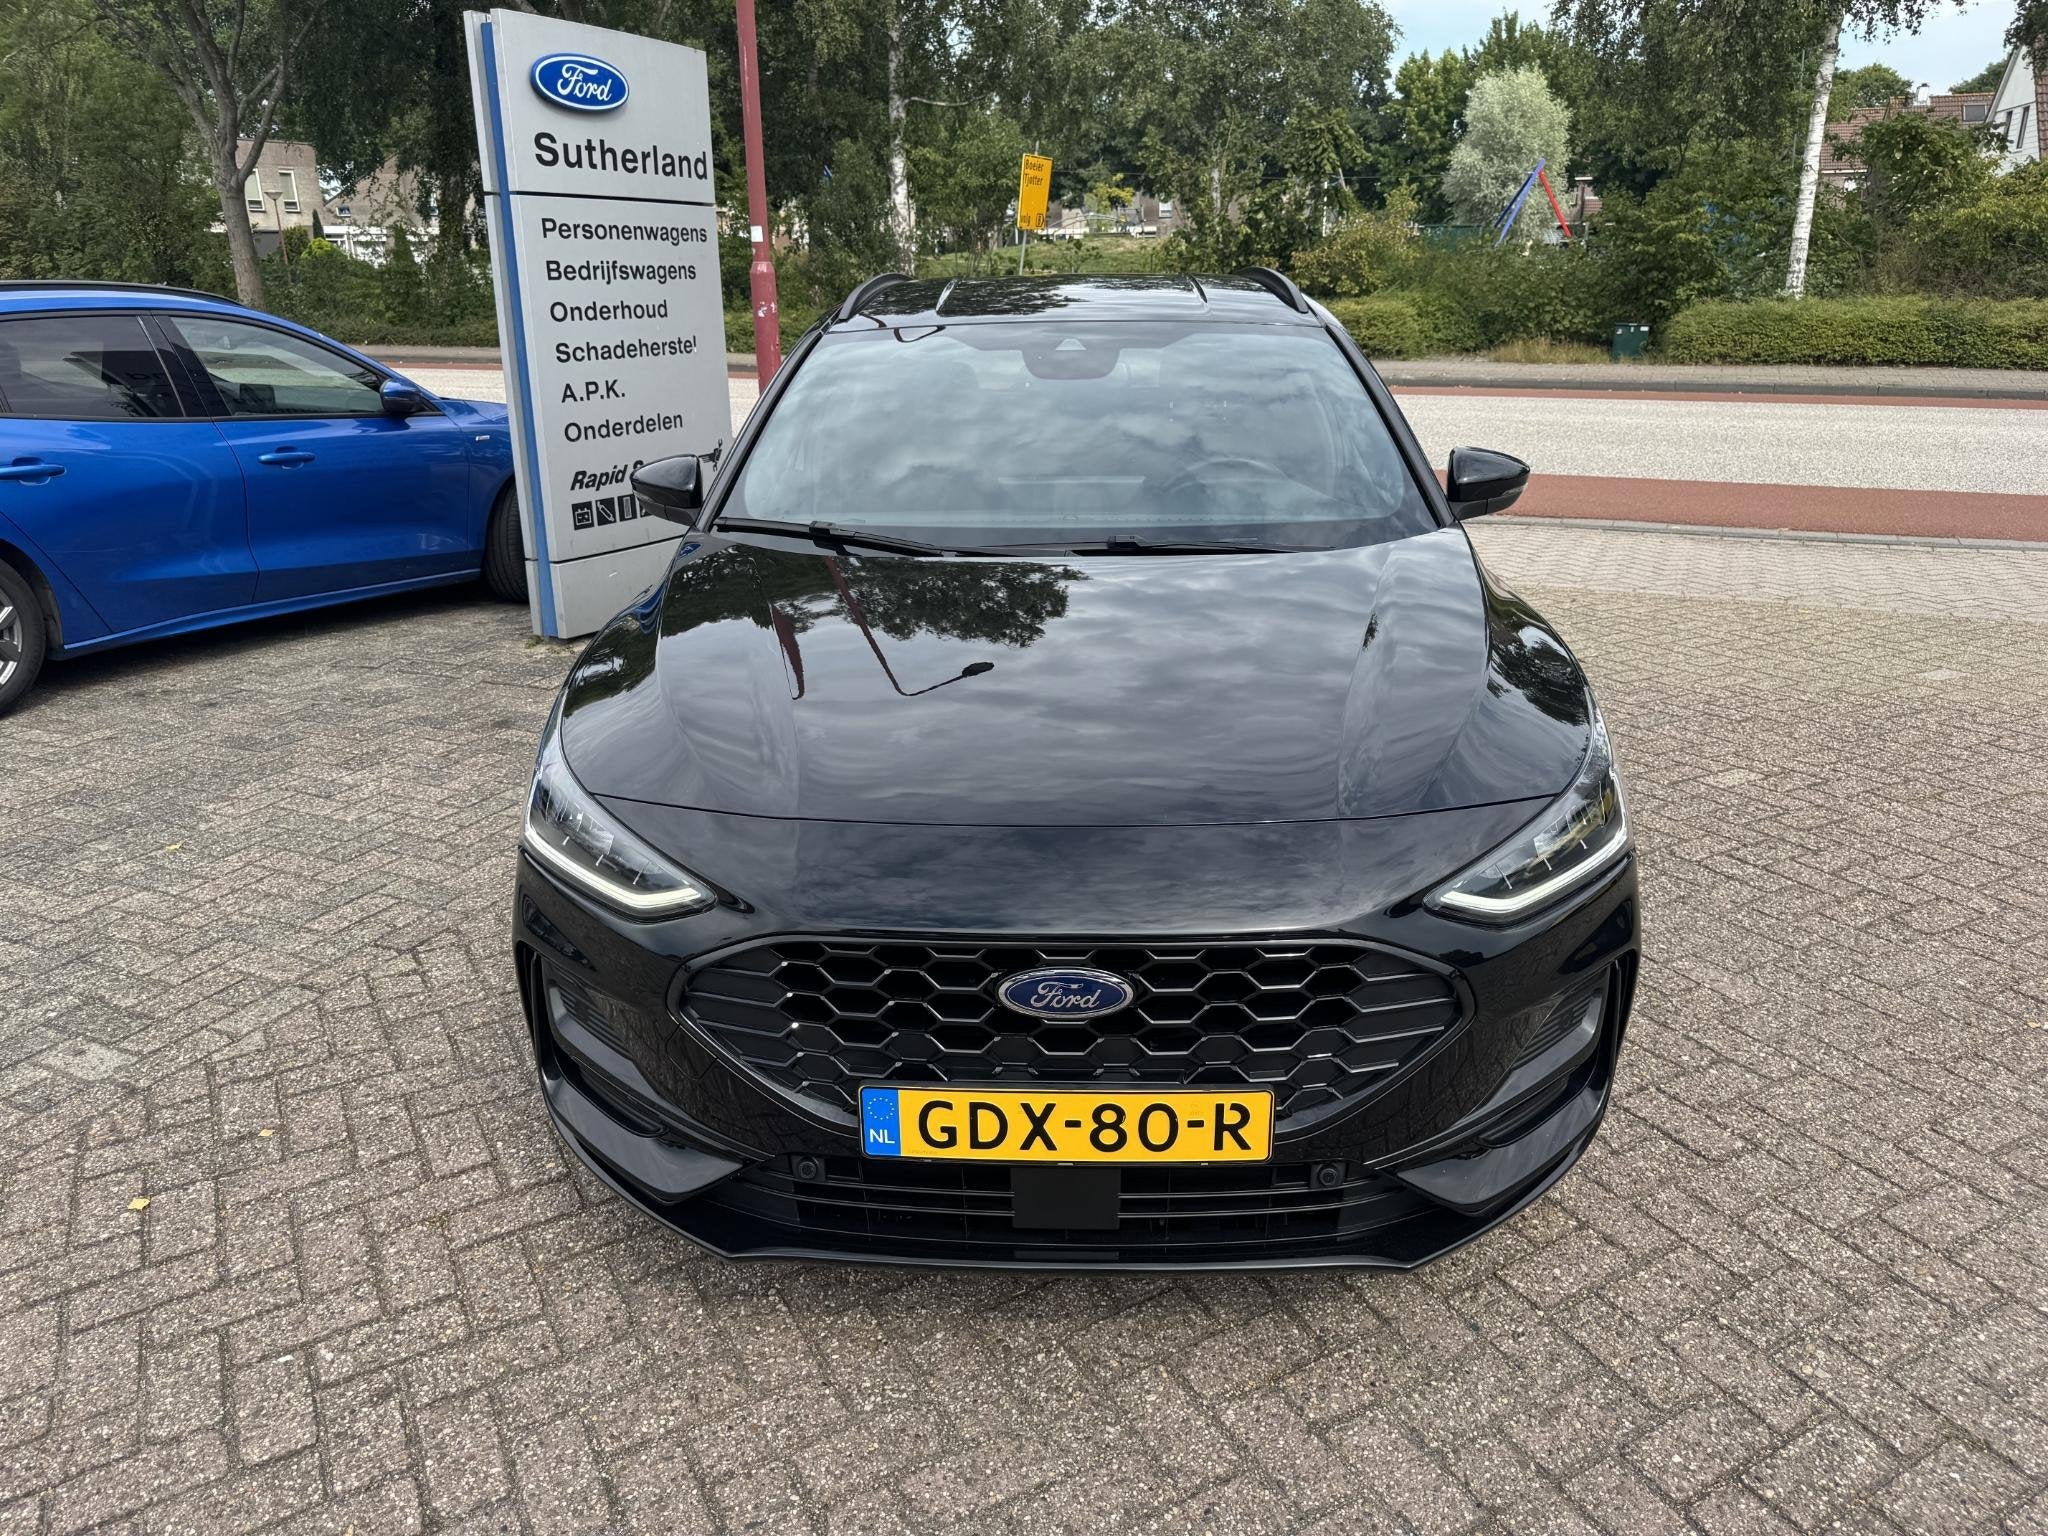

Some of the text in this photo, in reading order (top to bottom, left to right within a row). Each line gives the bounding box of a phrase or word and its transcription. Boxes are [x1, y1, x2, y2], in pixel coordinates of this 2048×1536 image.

[557, 63, 612, 101] Ford
[534, 132, 708, 180] Sutherland
[541, 217, 708, 246] Personenwagens
[546, 260, 697, 285] Bedrijfswagens
[550, 299, 668, 323] Onderhoud
[556, 335, 697, 363] Schadeherstel
[561, 379, 626, 403] A.P.K.
[564, 413, 683, 443] Onderdelen
[570, 463, 628, 492] Rapid
[1030, 981, 1100, 1010] Ford
[869, 1128, 895, 1145] NL
[918, 1100, 1251, 1152] GDX-80-R
